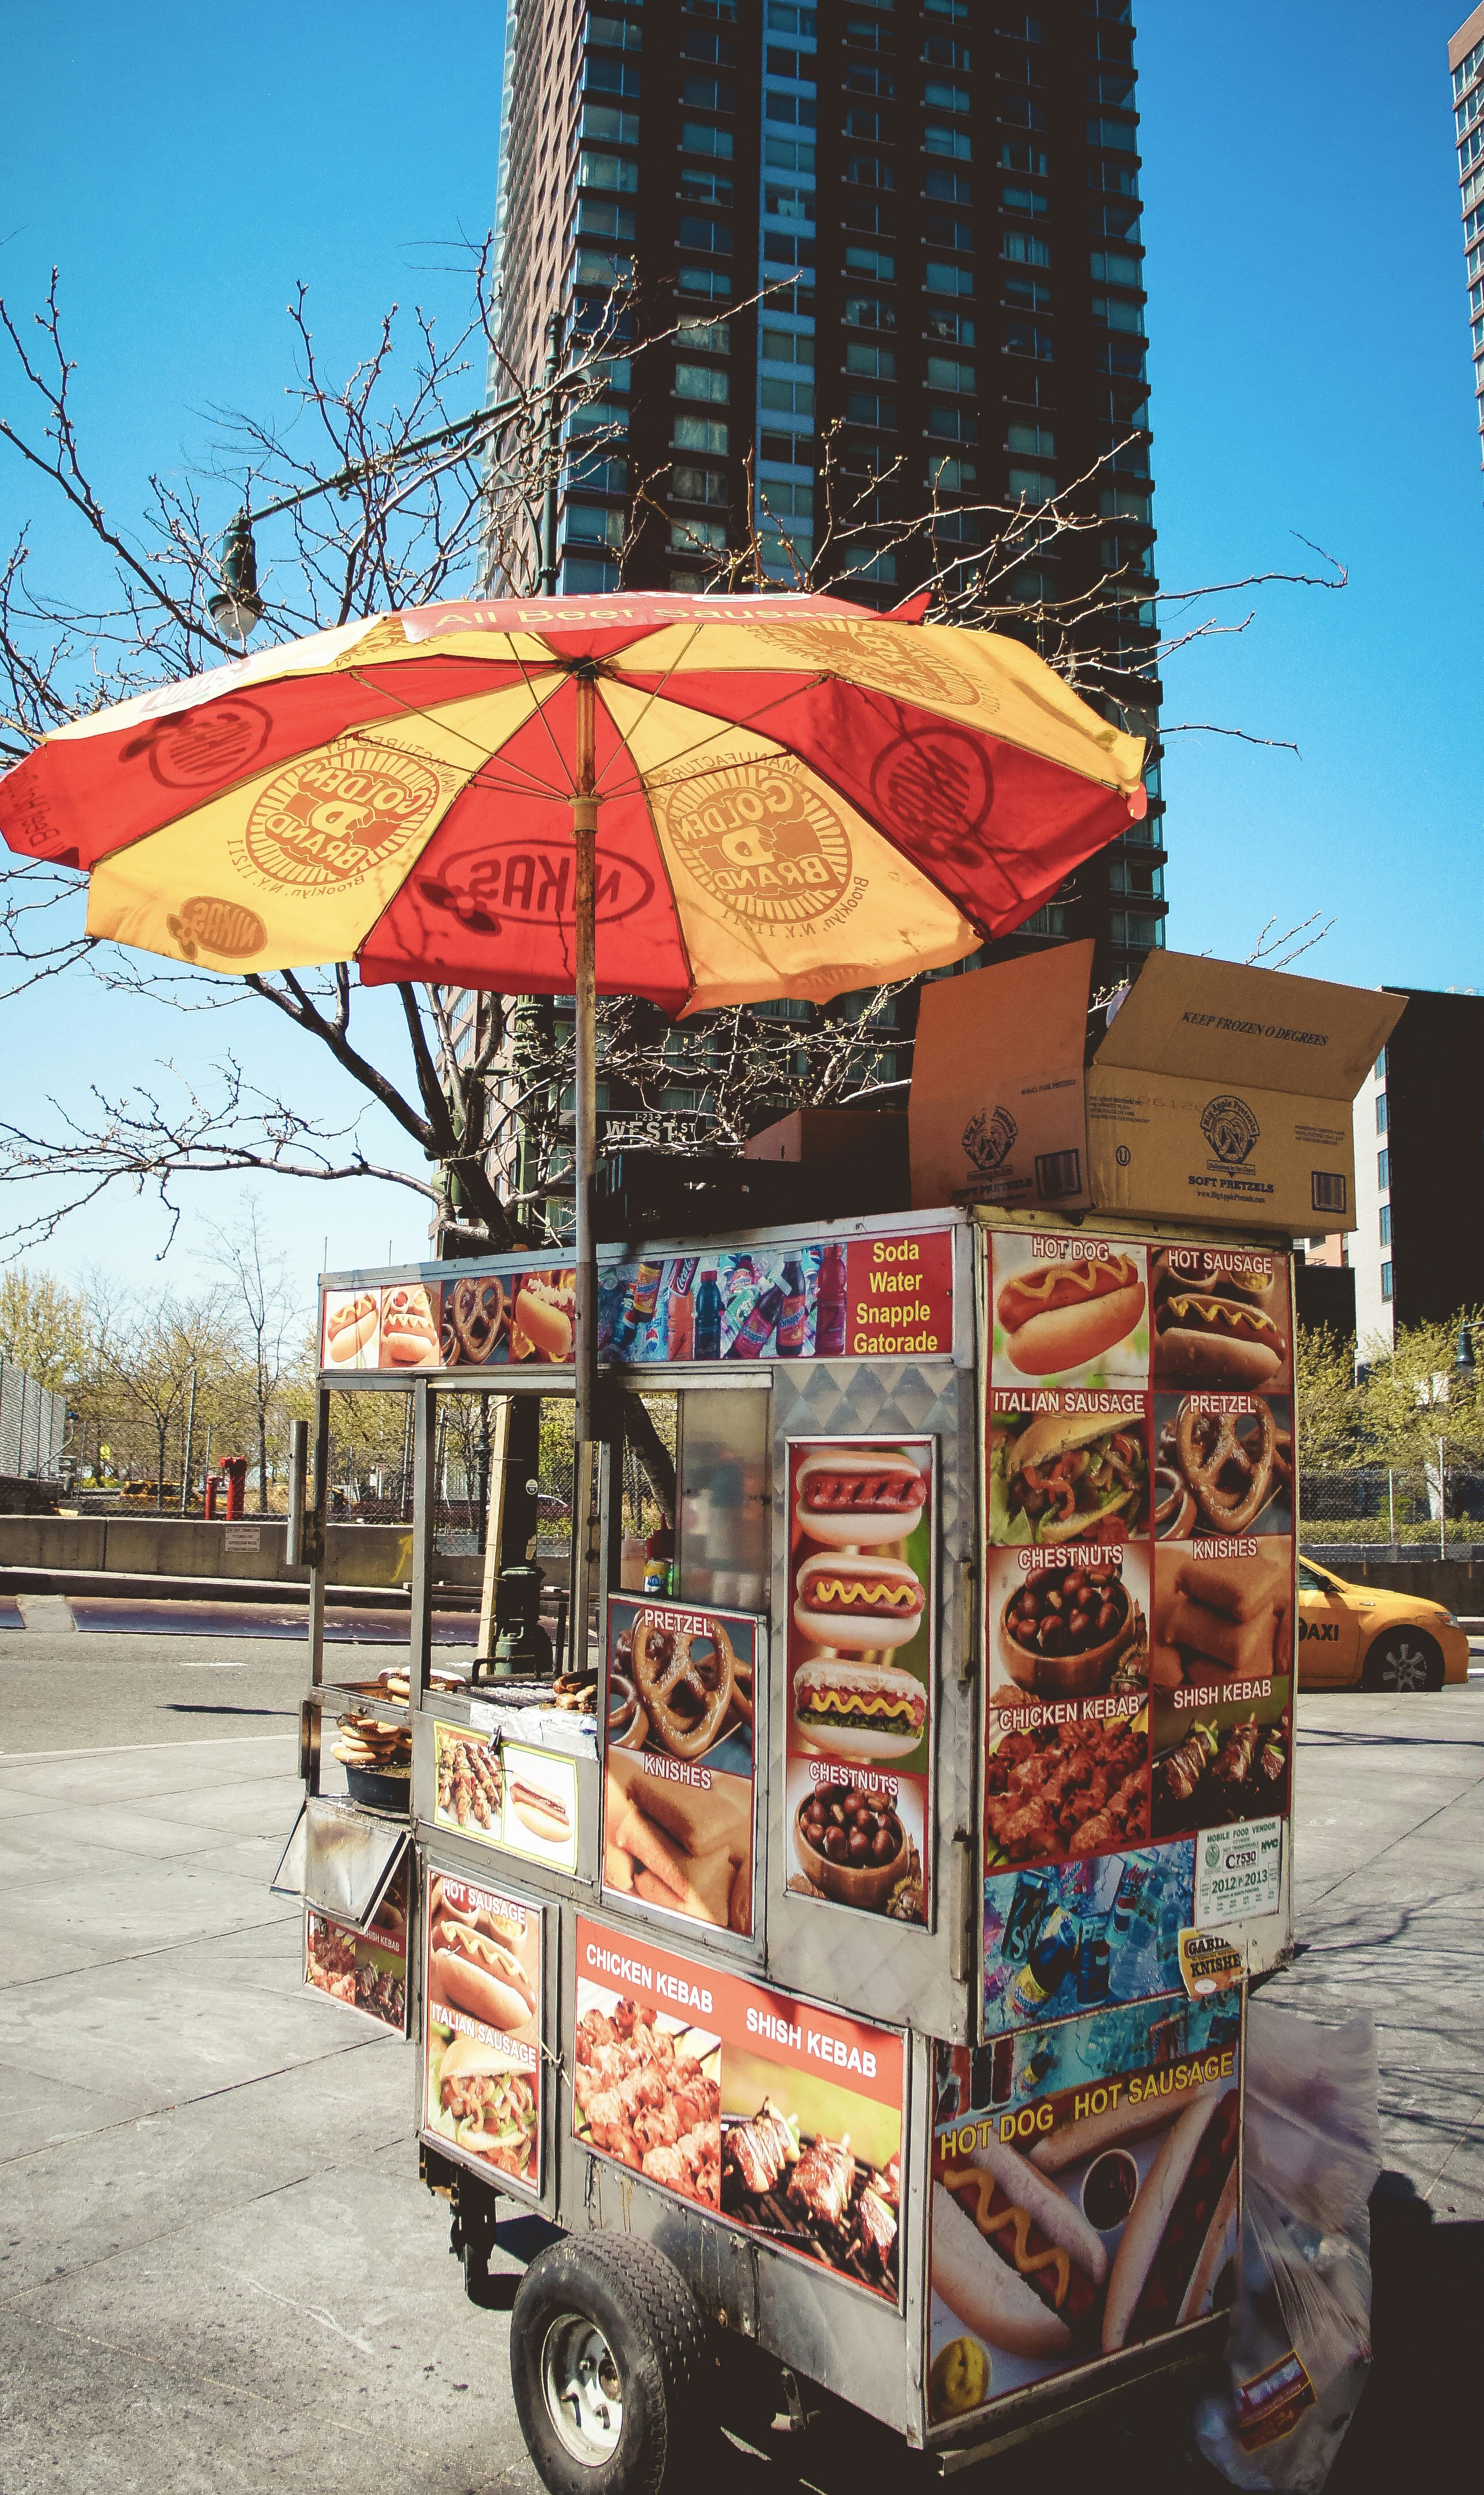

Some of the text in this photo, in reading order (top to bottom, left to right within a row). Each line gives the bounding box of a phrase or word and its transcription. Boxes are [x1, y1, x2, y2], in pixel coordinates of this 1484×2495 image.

[435, 611, 497, 628] All
[517, 608, 634, 623] Beef
[1182, 1010, 1217, 1027] KEEP
[1214, 1016, 1266, 1035] FROZEN
[1274, 1027, 1330, 1047] DEGREES
[605, 1121, 696, 1141] WEST ST
[1188, 1175, 1275, 1194] SOFT PRETZELS
[873, 1240, 919, 1263] Soda
[1032, 1237, 1110, 1261] HOT DOG
[1168, 1249, 1273, 1275] HOT SAUSAGE
[869, 1271, 923, 1294] Water
[856, 1300, 931, 1330] Snapple
[854, 1332, 938, 1354] Gatorade
[994, 1392, 1145, 1414] ITALIAN SAUSAGE
[1190, 1395, 1256, 1414] PRETZEL
[1019, 1545, 1124, 1570] CHESTNUTS
[1192, 1538, 1258, 1560] KNISHES
[644, 1609, 714, 1638] PRETZEL
[1304, 1622, 1339, 1642] AXI
[1173, 1679, 1272, 1709] SHISH KEBAB
[999, 1695, 1140, 1730] CHICKEN KEBAB
[643, 1755, 712, 1790] KNISHES
[809, 1761, 899, 1796] CHESTNUTS
[1206, 1821, 1277, 1844] MOBILE FOOD VENDOR
[1212, 1876, 1236, 1894] 2012
[1244, 1869, 1268, 1887] 2013
[441, 1878, 527, 1925] HOT SAUSAGE
[380, 1935, 400, 1952] KEBAB
[585, 1943, 714, 2014] CHICKEN KEBAB
[431, 2003, 537, 2066] ITALIAN SAUSAGE
[745, 2007, 877, 2079] SHISH KEBAB
[940, 2051, 1234, 2160] HOT DOG HOT SAUSAGE
